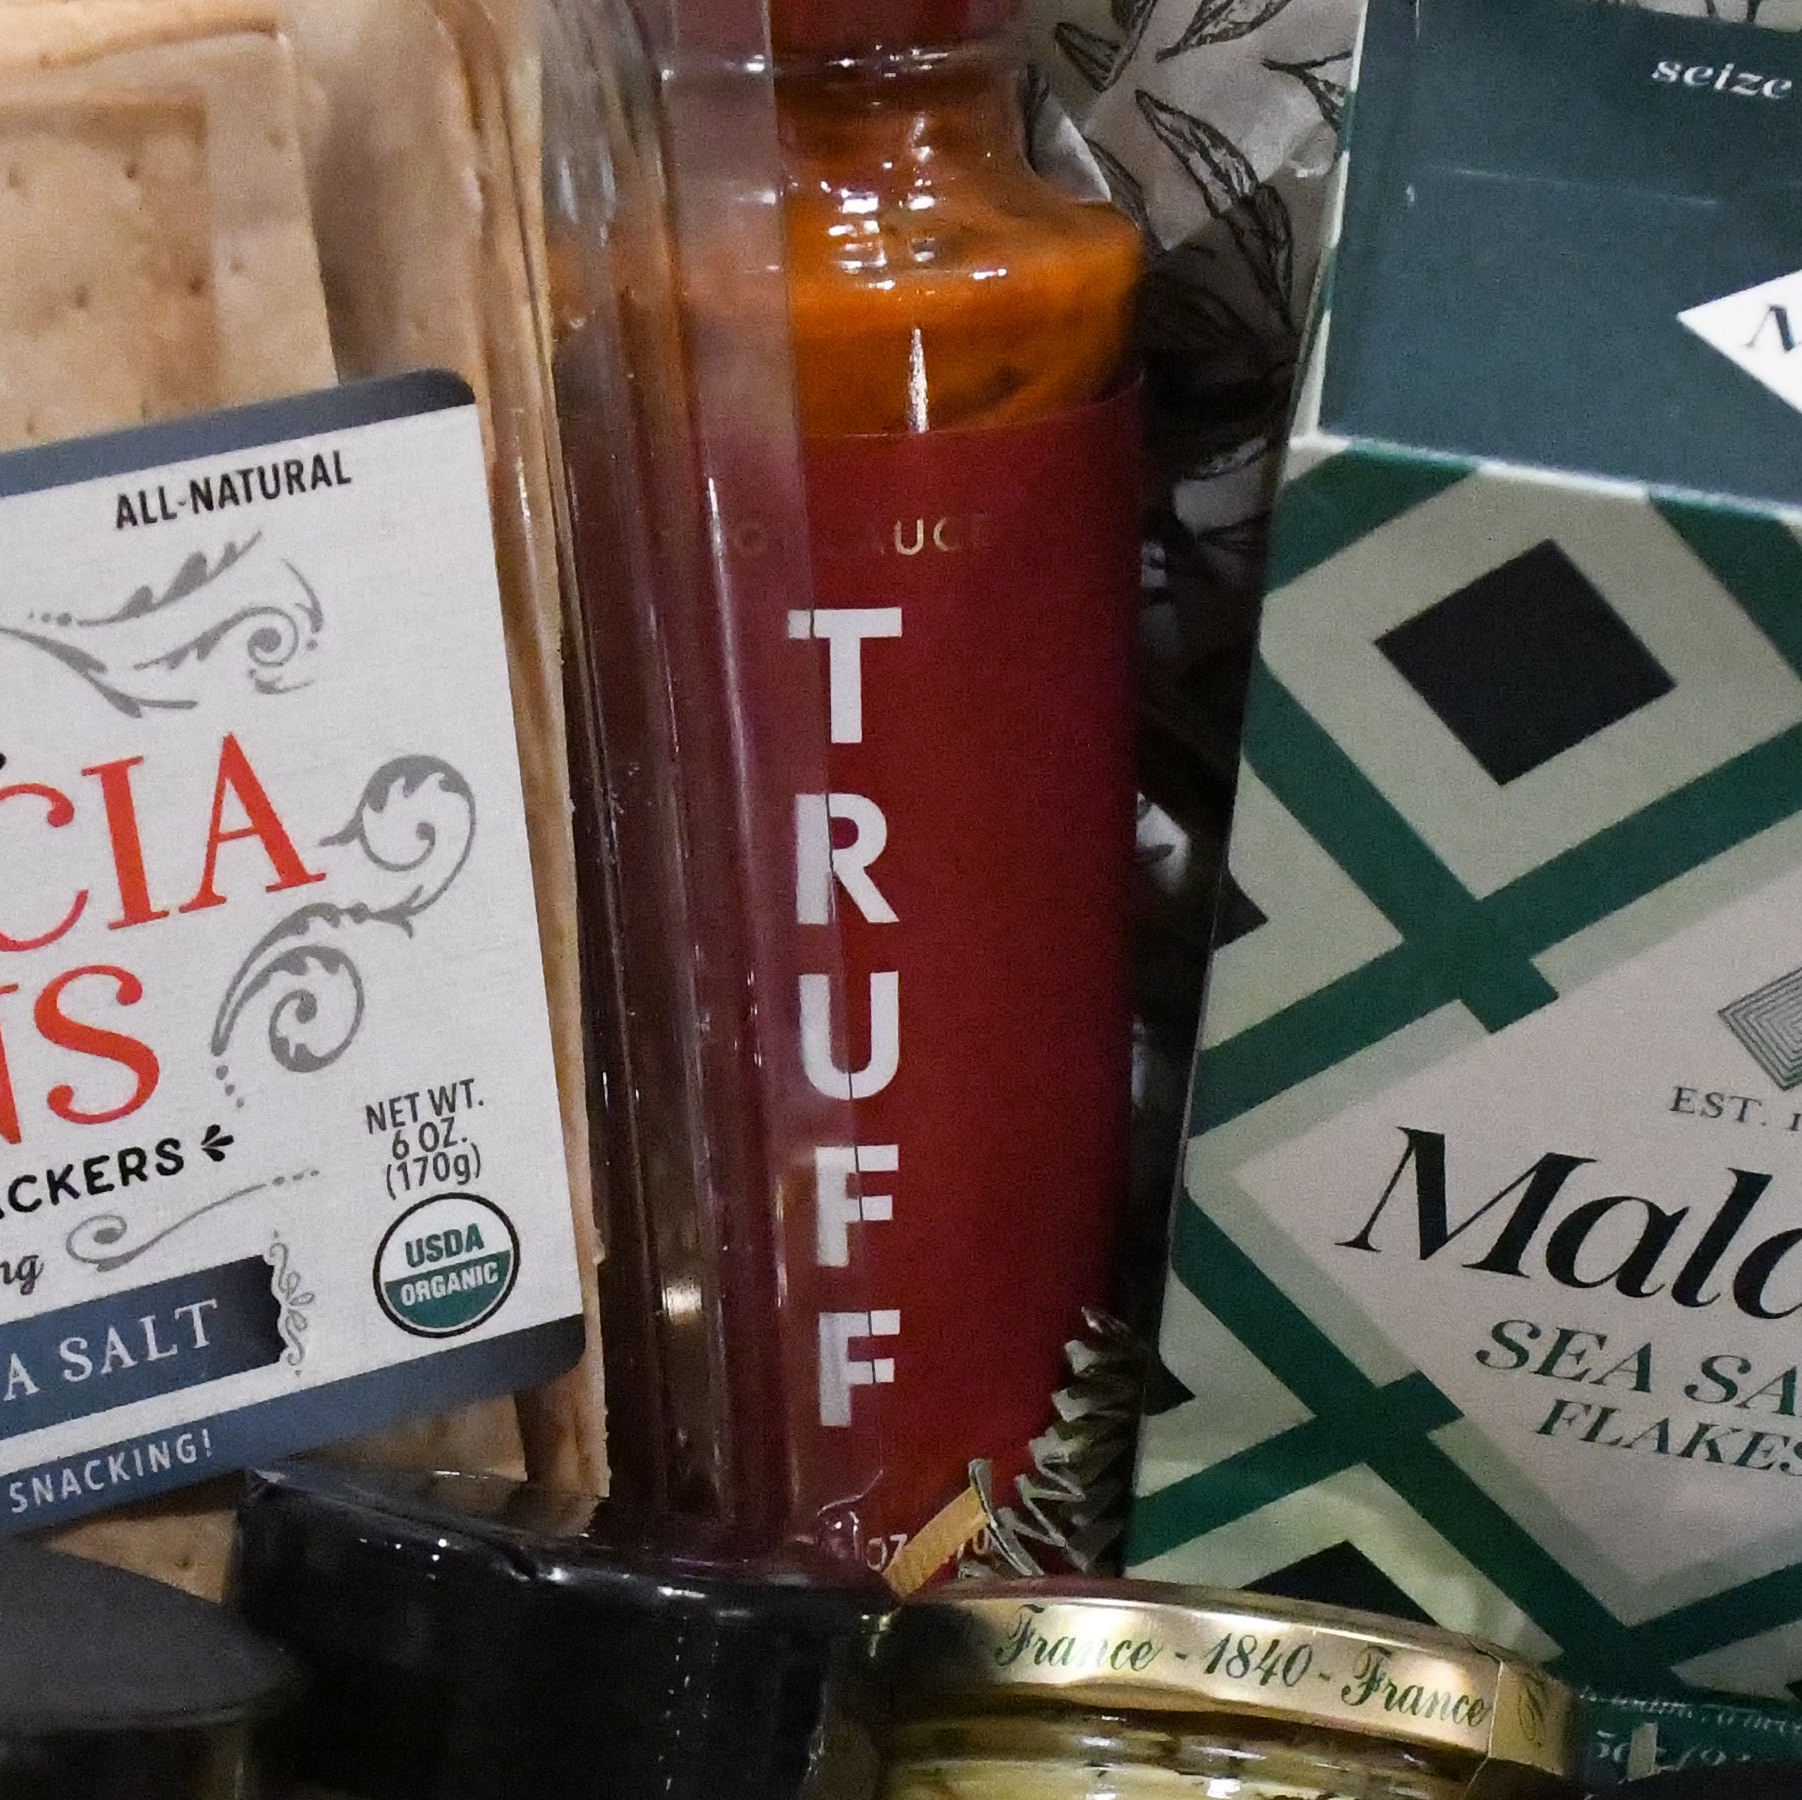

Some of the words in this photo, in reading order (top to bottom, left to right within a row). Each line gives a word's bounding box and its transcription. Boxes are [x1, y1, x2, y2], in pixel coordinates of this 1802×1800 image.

[1652, 54, 1791, 100] seize
[114, 449, 352, 531] ALL-NATURAL
[787, 606, 903, 1428] TRUFF
[365, 1090, 422, 1137] NET
[426, 1077, 486, 1124] WT.
[1668, 1085, 1771, 1128] EST.
[384, 1143, 483, 1200] (170g)
[390, 1130, 413, 1160] 6
[403, 1222, 485, 1271] USDA
[397, 1257, 503, 1309] ORGANIC
[59, 1297, 222, 1385] SALT
[1474, 1317, 1657, 1394] SEA
[8, 1427, 215, 1514] SNACKING!
[997, 1603, 1159, 1673] France
[1203, 1632, 1314, 1689] 1840
[1341, 1644, 1493, 1727] France
